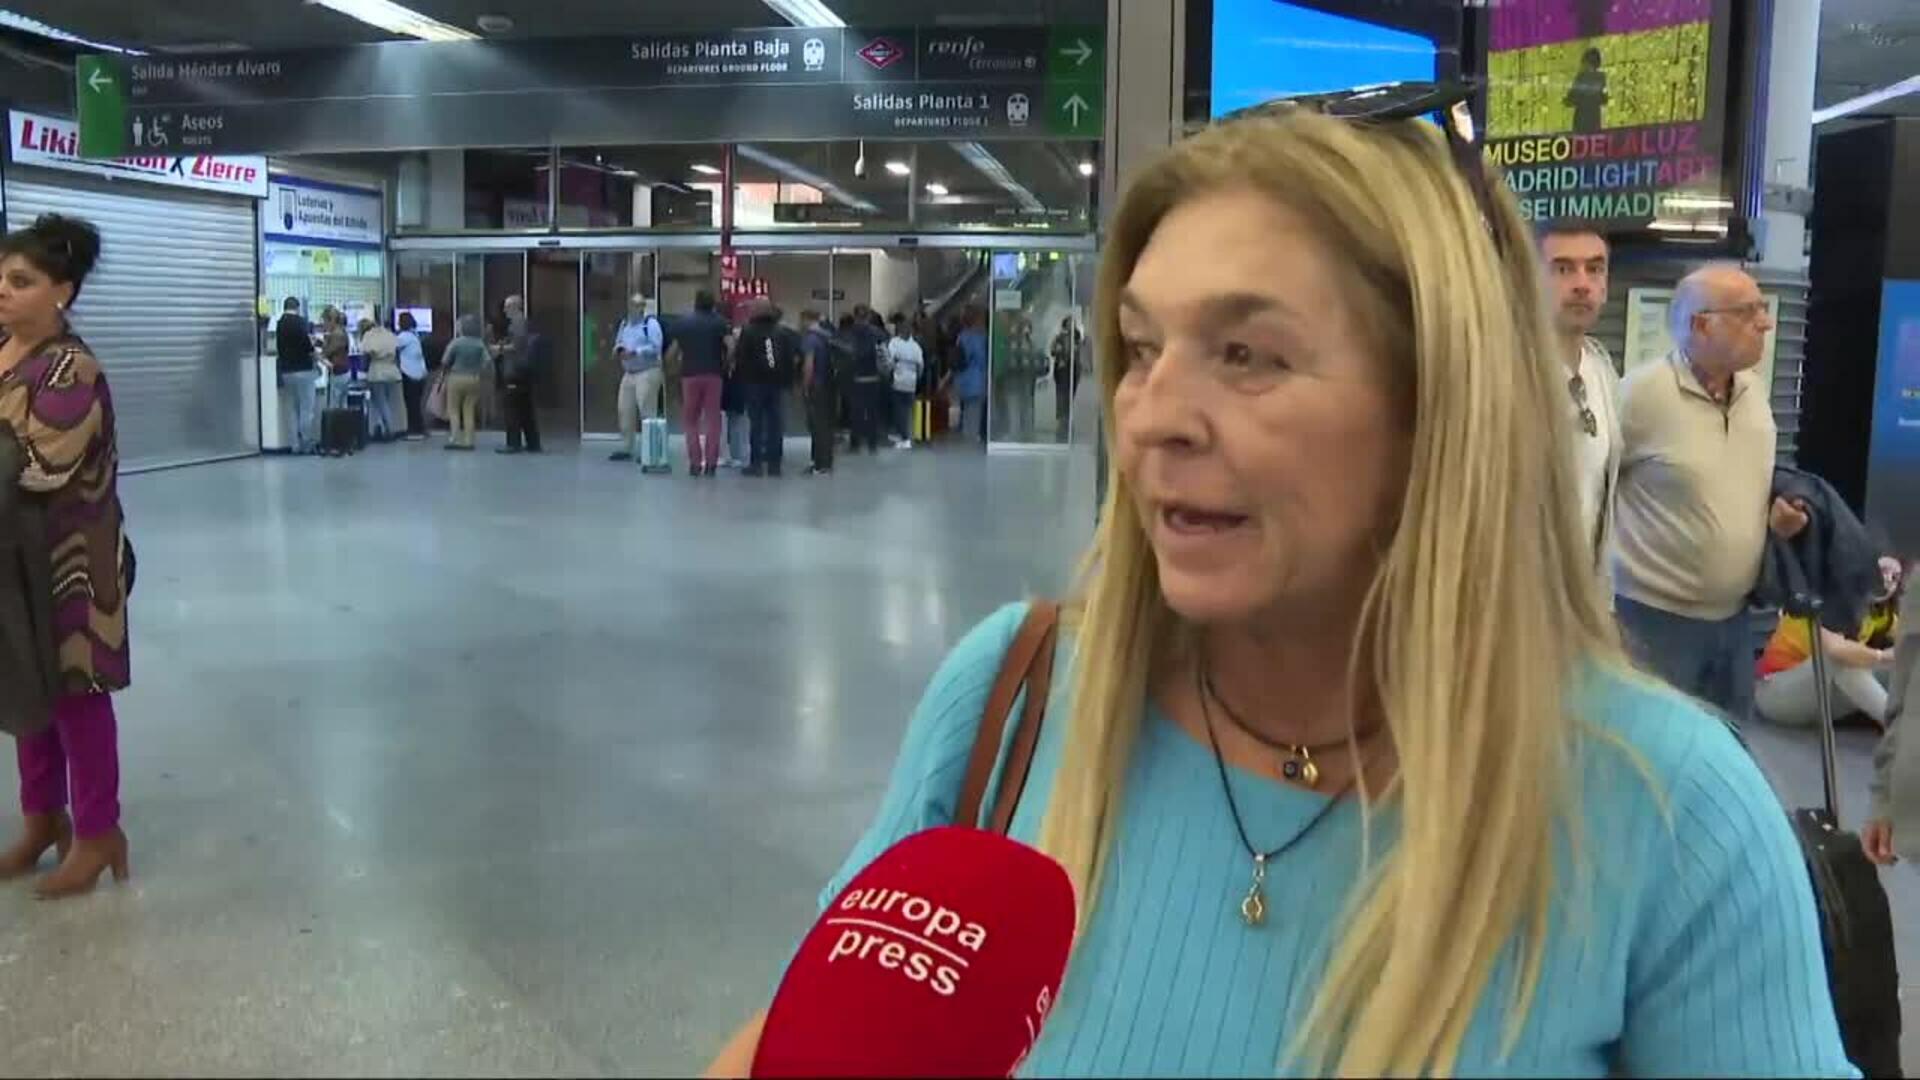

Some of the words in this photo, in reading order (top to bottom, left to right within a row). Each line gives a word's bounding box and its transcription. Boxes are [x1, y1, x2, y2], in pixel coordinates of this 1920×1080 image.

[631, 39, 690, 60] Salidas
[694, 39, 747, 58] Planta
[753, 38, 791, 59] Baja
[927, 36, 985, 59] renfe
[131, 61, 174, 81] Salida
[178, 60, 232, 79] Méndez
[666, 64, 721, 75] DEPARTURES
[722, 63, 759, 73] GROUND
[760, 62, 789, 73] FLOOR
[852, 92, 913, 111] Salidas
[919, 91, 974, 110] Planta
[979, 94, 989, 109] 1
[181, 114, 224, 131] Aseos
[894, 116, 951, 128] DEPARTURES
[191, 153, 257, 184] Zierre
[840, 887, 987, 953] europa
[827, 928, 961, 997] press
